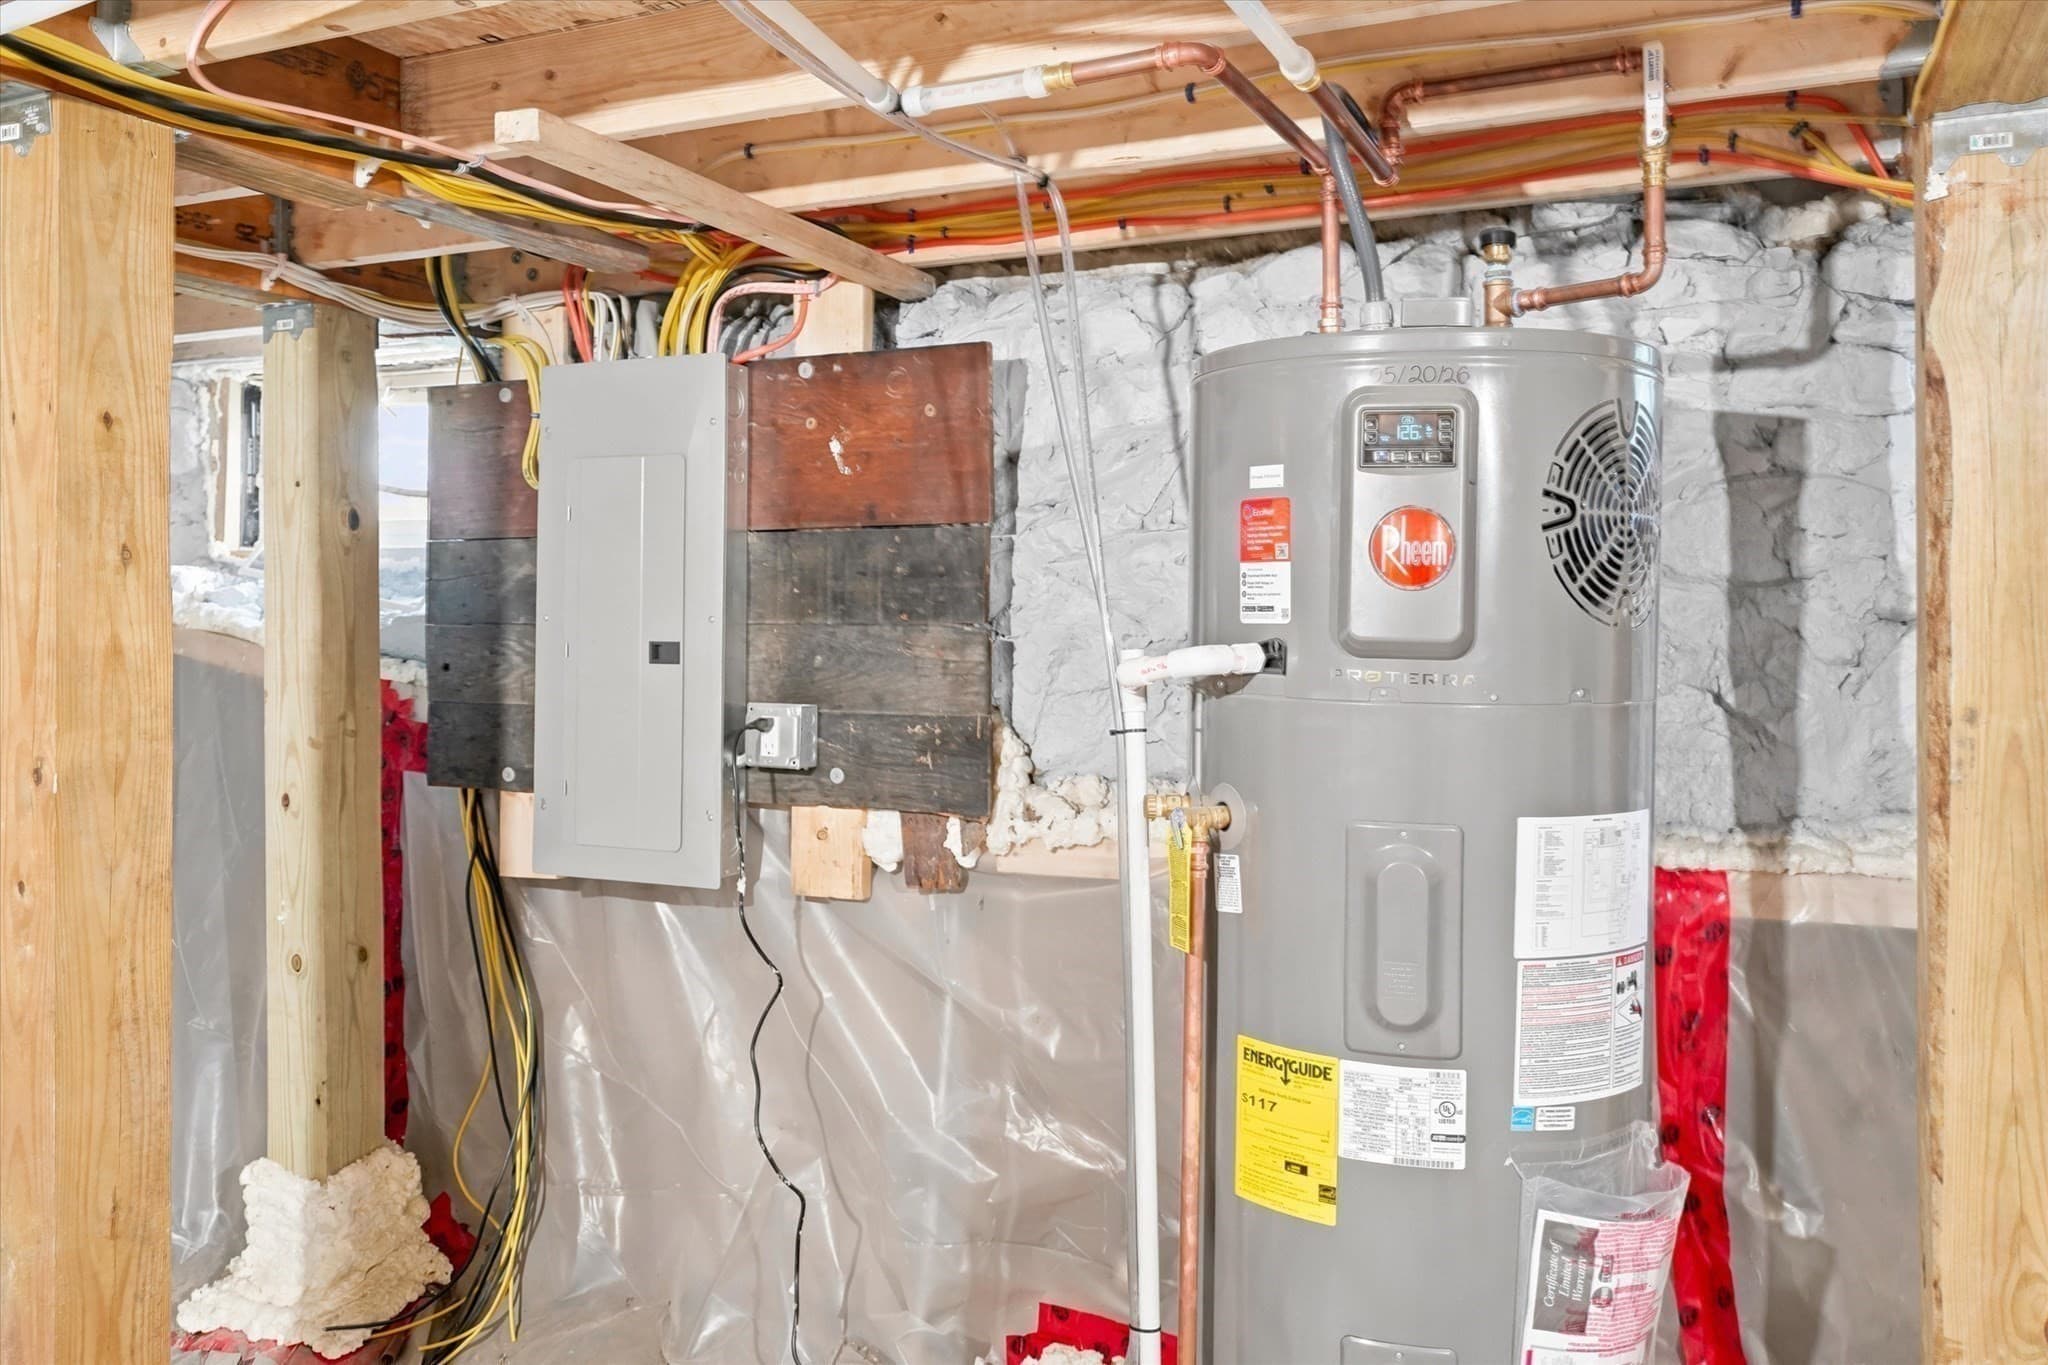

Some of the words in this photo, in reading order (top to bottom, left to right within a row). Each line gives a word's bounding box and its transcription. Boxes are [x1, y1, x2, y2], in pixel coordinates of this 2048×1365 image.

[1381, 515, 1448, 577] Rheem
[1241, 1092, 1278, 1112] $117
[1549, 1238, 1563, 1253] of
[1543, 1253, 1560, 1308] Certificate
[1558, 1256, 1573, 1297] Limited
